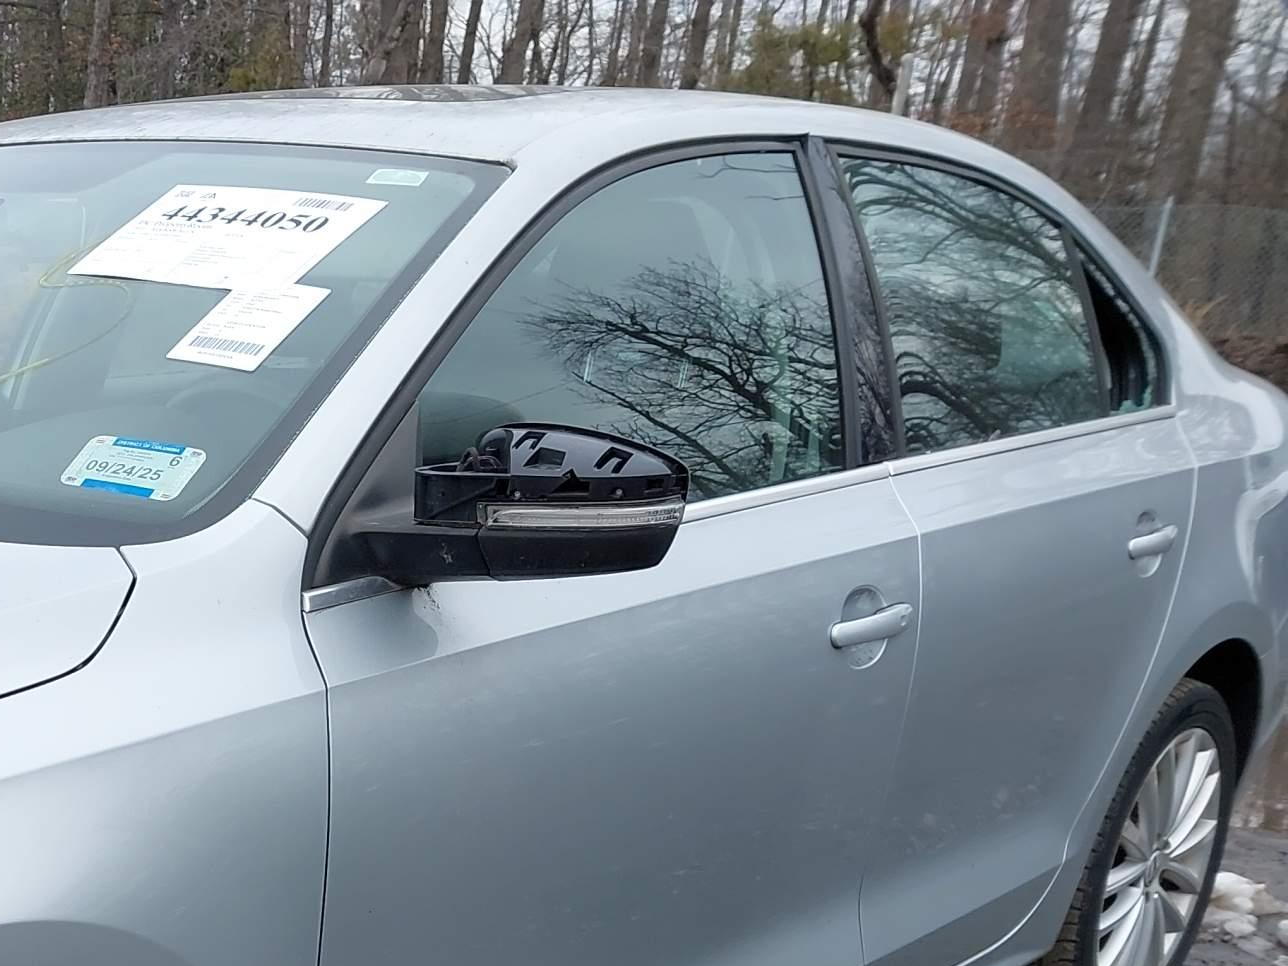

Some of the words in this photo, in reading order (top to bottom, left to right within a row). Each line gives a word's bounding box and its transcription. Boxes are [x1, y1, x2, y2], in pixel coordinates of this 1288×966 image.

[161, 204, 330, 233] 44344050
[85, 459, 164, 481] 09/24/25
[169, 456, 183, 467] 6
